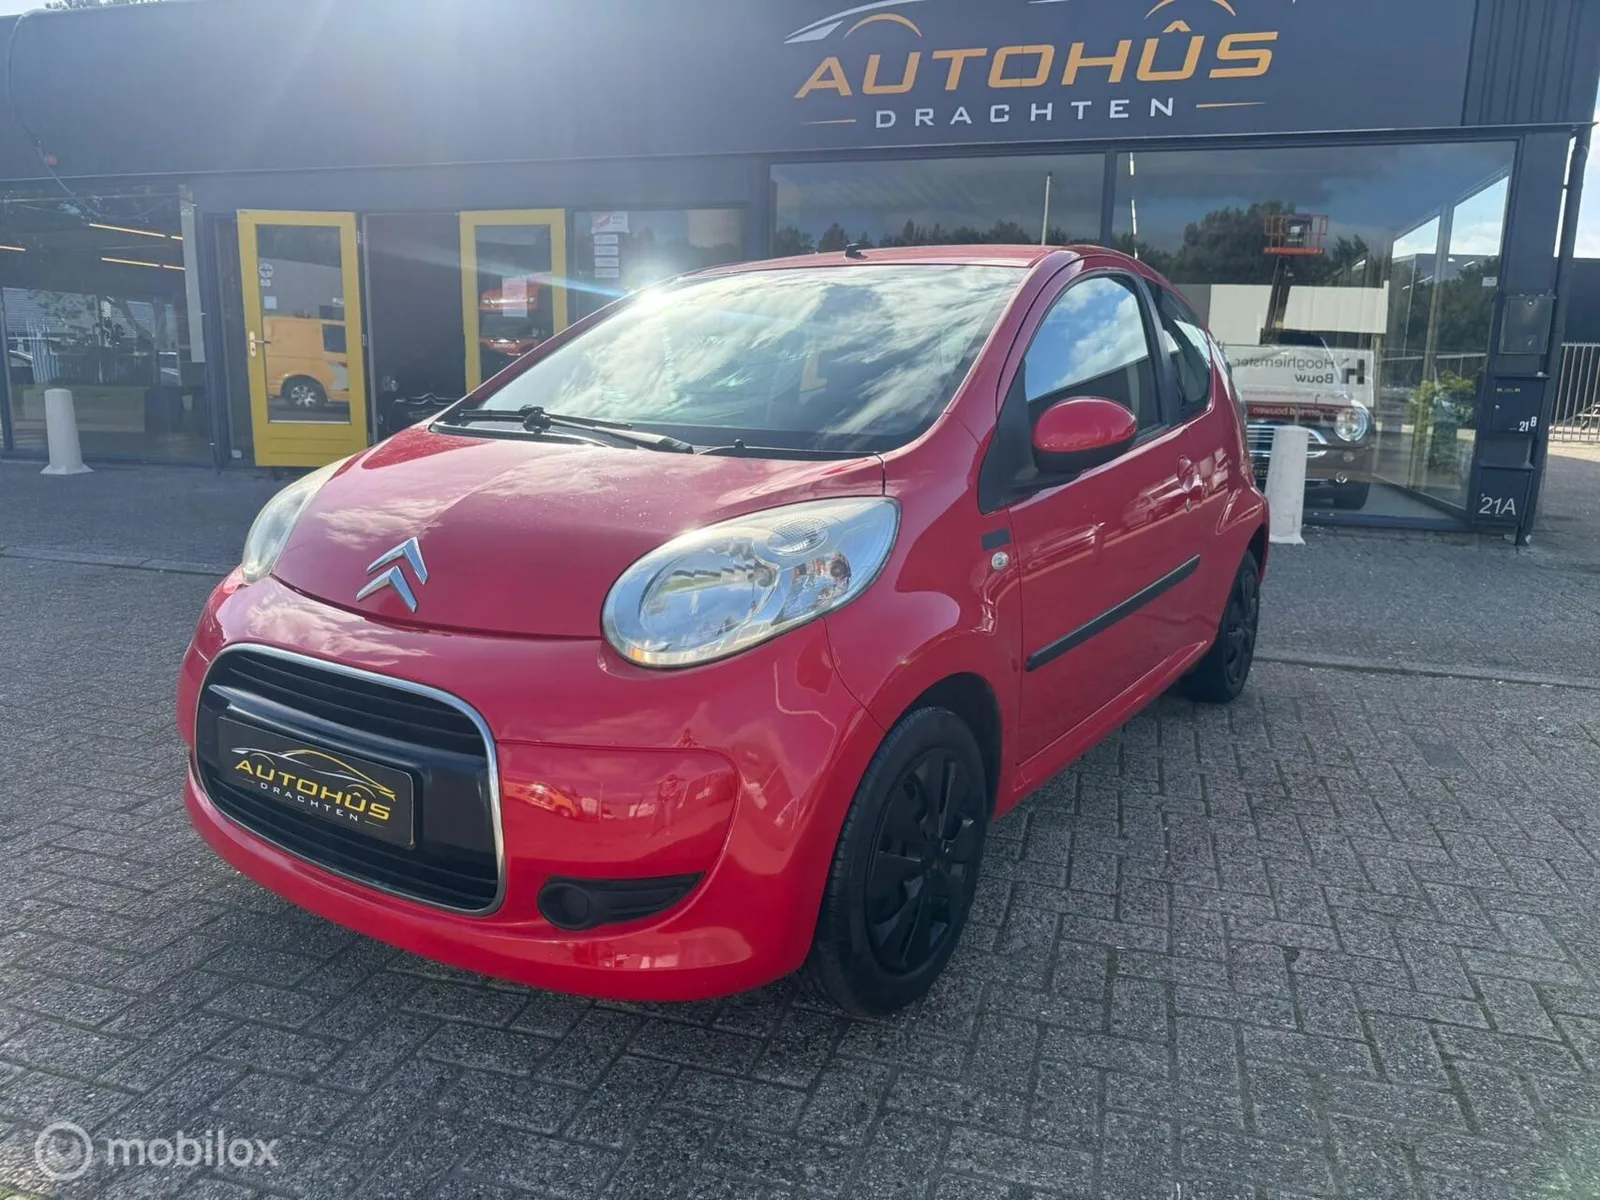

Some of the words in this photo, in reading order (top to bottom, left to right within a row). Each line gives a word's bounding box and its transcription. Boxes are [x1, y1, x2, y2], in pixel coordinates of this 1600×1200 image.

[794, 20, 1279, 98] AUTOHÛS
[875, 98, 1174, 128] DRACHTEN
[1479, 497, 1516, 515] 21A
[235, 760, 391, 821] AUTOHÛS
[260, 782, 358, 821] DRACHTEN
